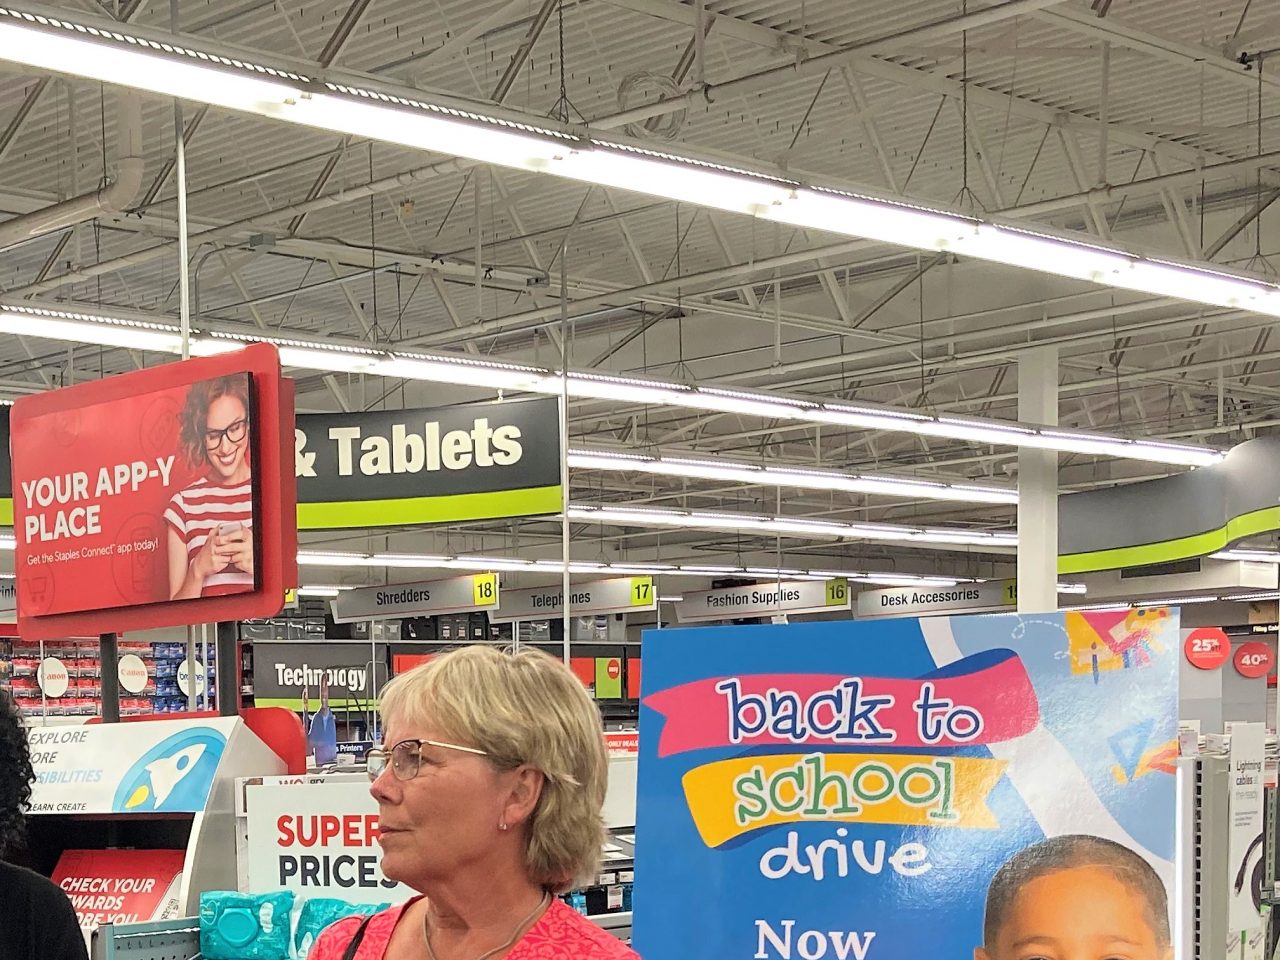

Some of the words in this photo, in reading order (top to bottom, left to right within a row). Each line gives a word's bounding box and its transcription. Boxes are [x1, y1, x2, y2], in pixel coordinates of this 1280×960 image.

[329, 418, 522, 476] Tablets
[21, 472, 89, 510] YOUR
[95, 456, 176, 498] APP-Y
[25, 506, 101, 544] PLACE
[27, 553, 41, 566] Get
[41, 551, 53, 564] the
[54, 548, 80, 564] Staples
[117, 543, 132, 556] app
[133, 538, 159, 555] today!
[376, 588, 430, 606] Shredders
[476, 583, 493, 599] 18
[634, 584, 650, 600] 17
[706, 594, 748, 608] Fashion
[752, 589, 800, 605] Supplies
[829, 585, 845, 600] 16
[881, 592, 908, 607] Desk
[911, 588, 980, 605] Accessories
[121, 668, 146, 678] Canon
[717, 680, 894, 741] back
[916, 685, 981, 741] to
[29, 731, 89, 744] EXPLORE
[339, 744, 364, 753] Printers
[30, 752, 58, 764] ORE
[36, 769, 103, 784] SIBILITIES
[735, 756, 957, 823] school
[56, 803, 87, 812] CREATE
[276, 814, 381, 847] SUPER
[760, 828, 933, 881] drive
[60, 877, 113, 893] CHECK
[113, 877, 156, 893] YOUR
[754, 919, 876, 960] Now
